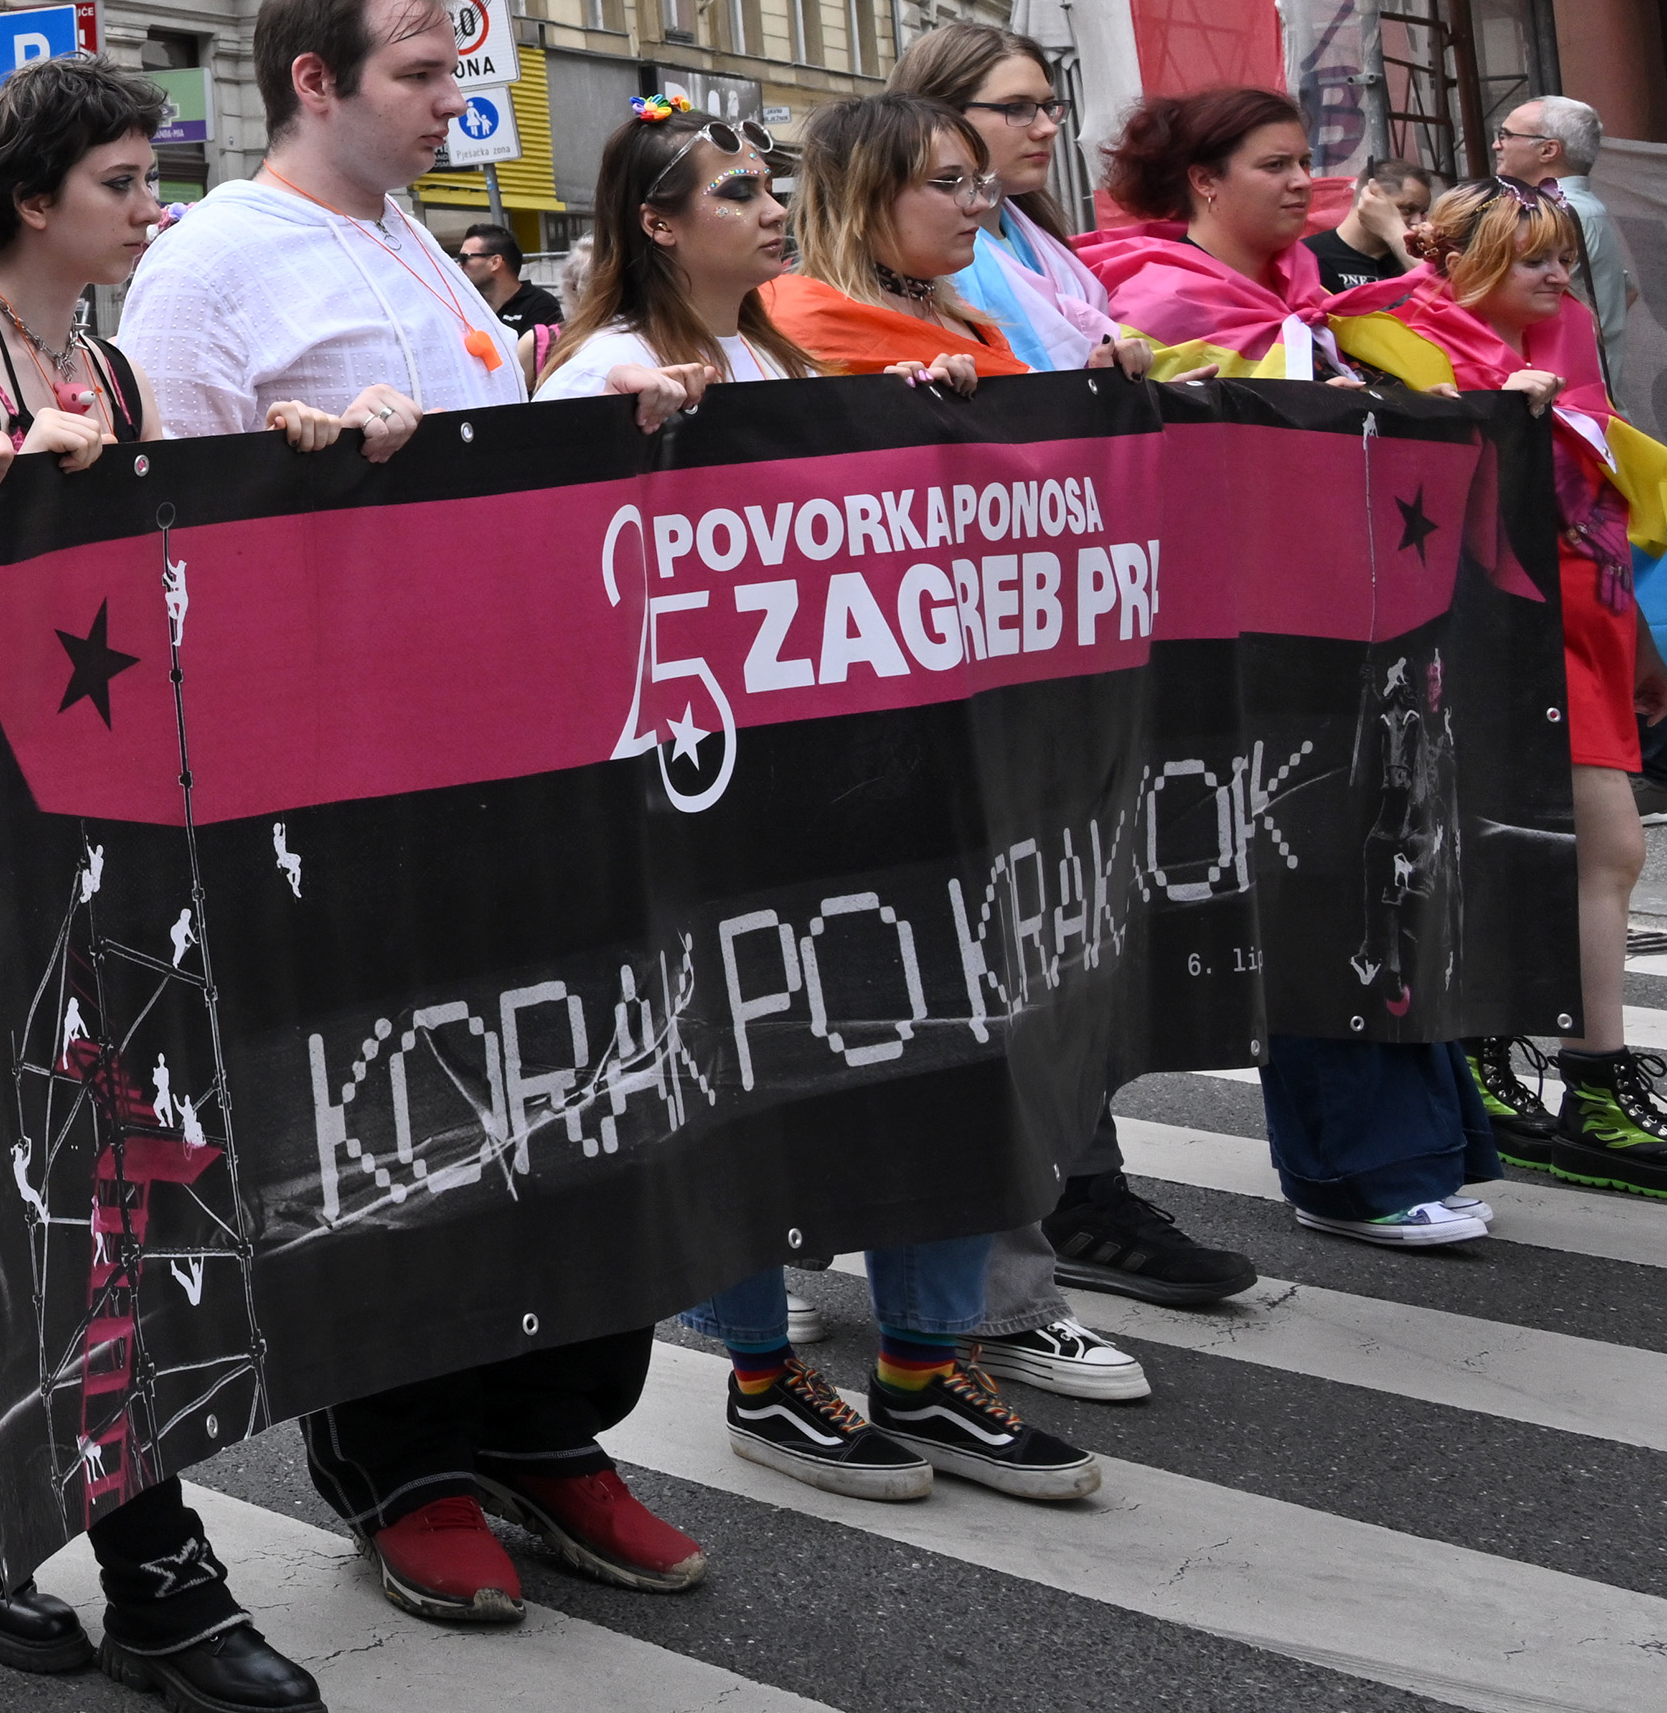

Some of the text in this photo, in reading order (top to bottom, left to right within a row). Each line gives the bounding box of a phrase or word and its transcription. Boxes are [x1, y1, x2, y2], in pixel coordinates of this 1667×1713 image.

[734, 551, 1063, 695] ZAGREB
[719, 892, 928, 1092] PO
[1188, 952, 1212, 977] 6.
